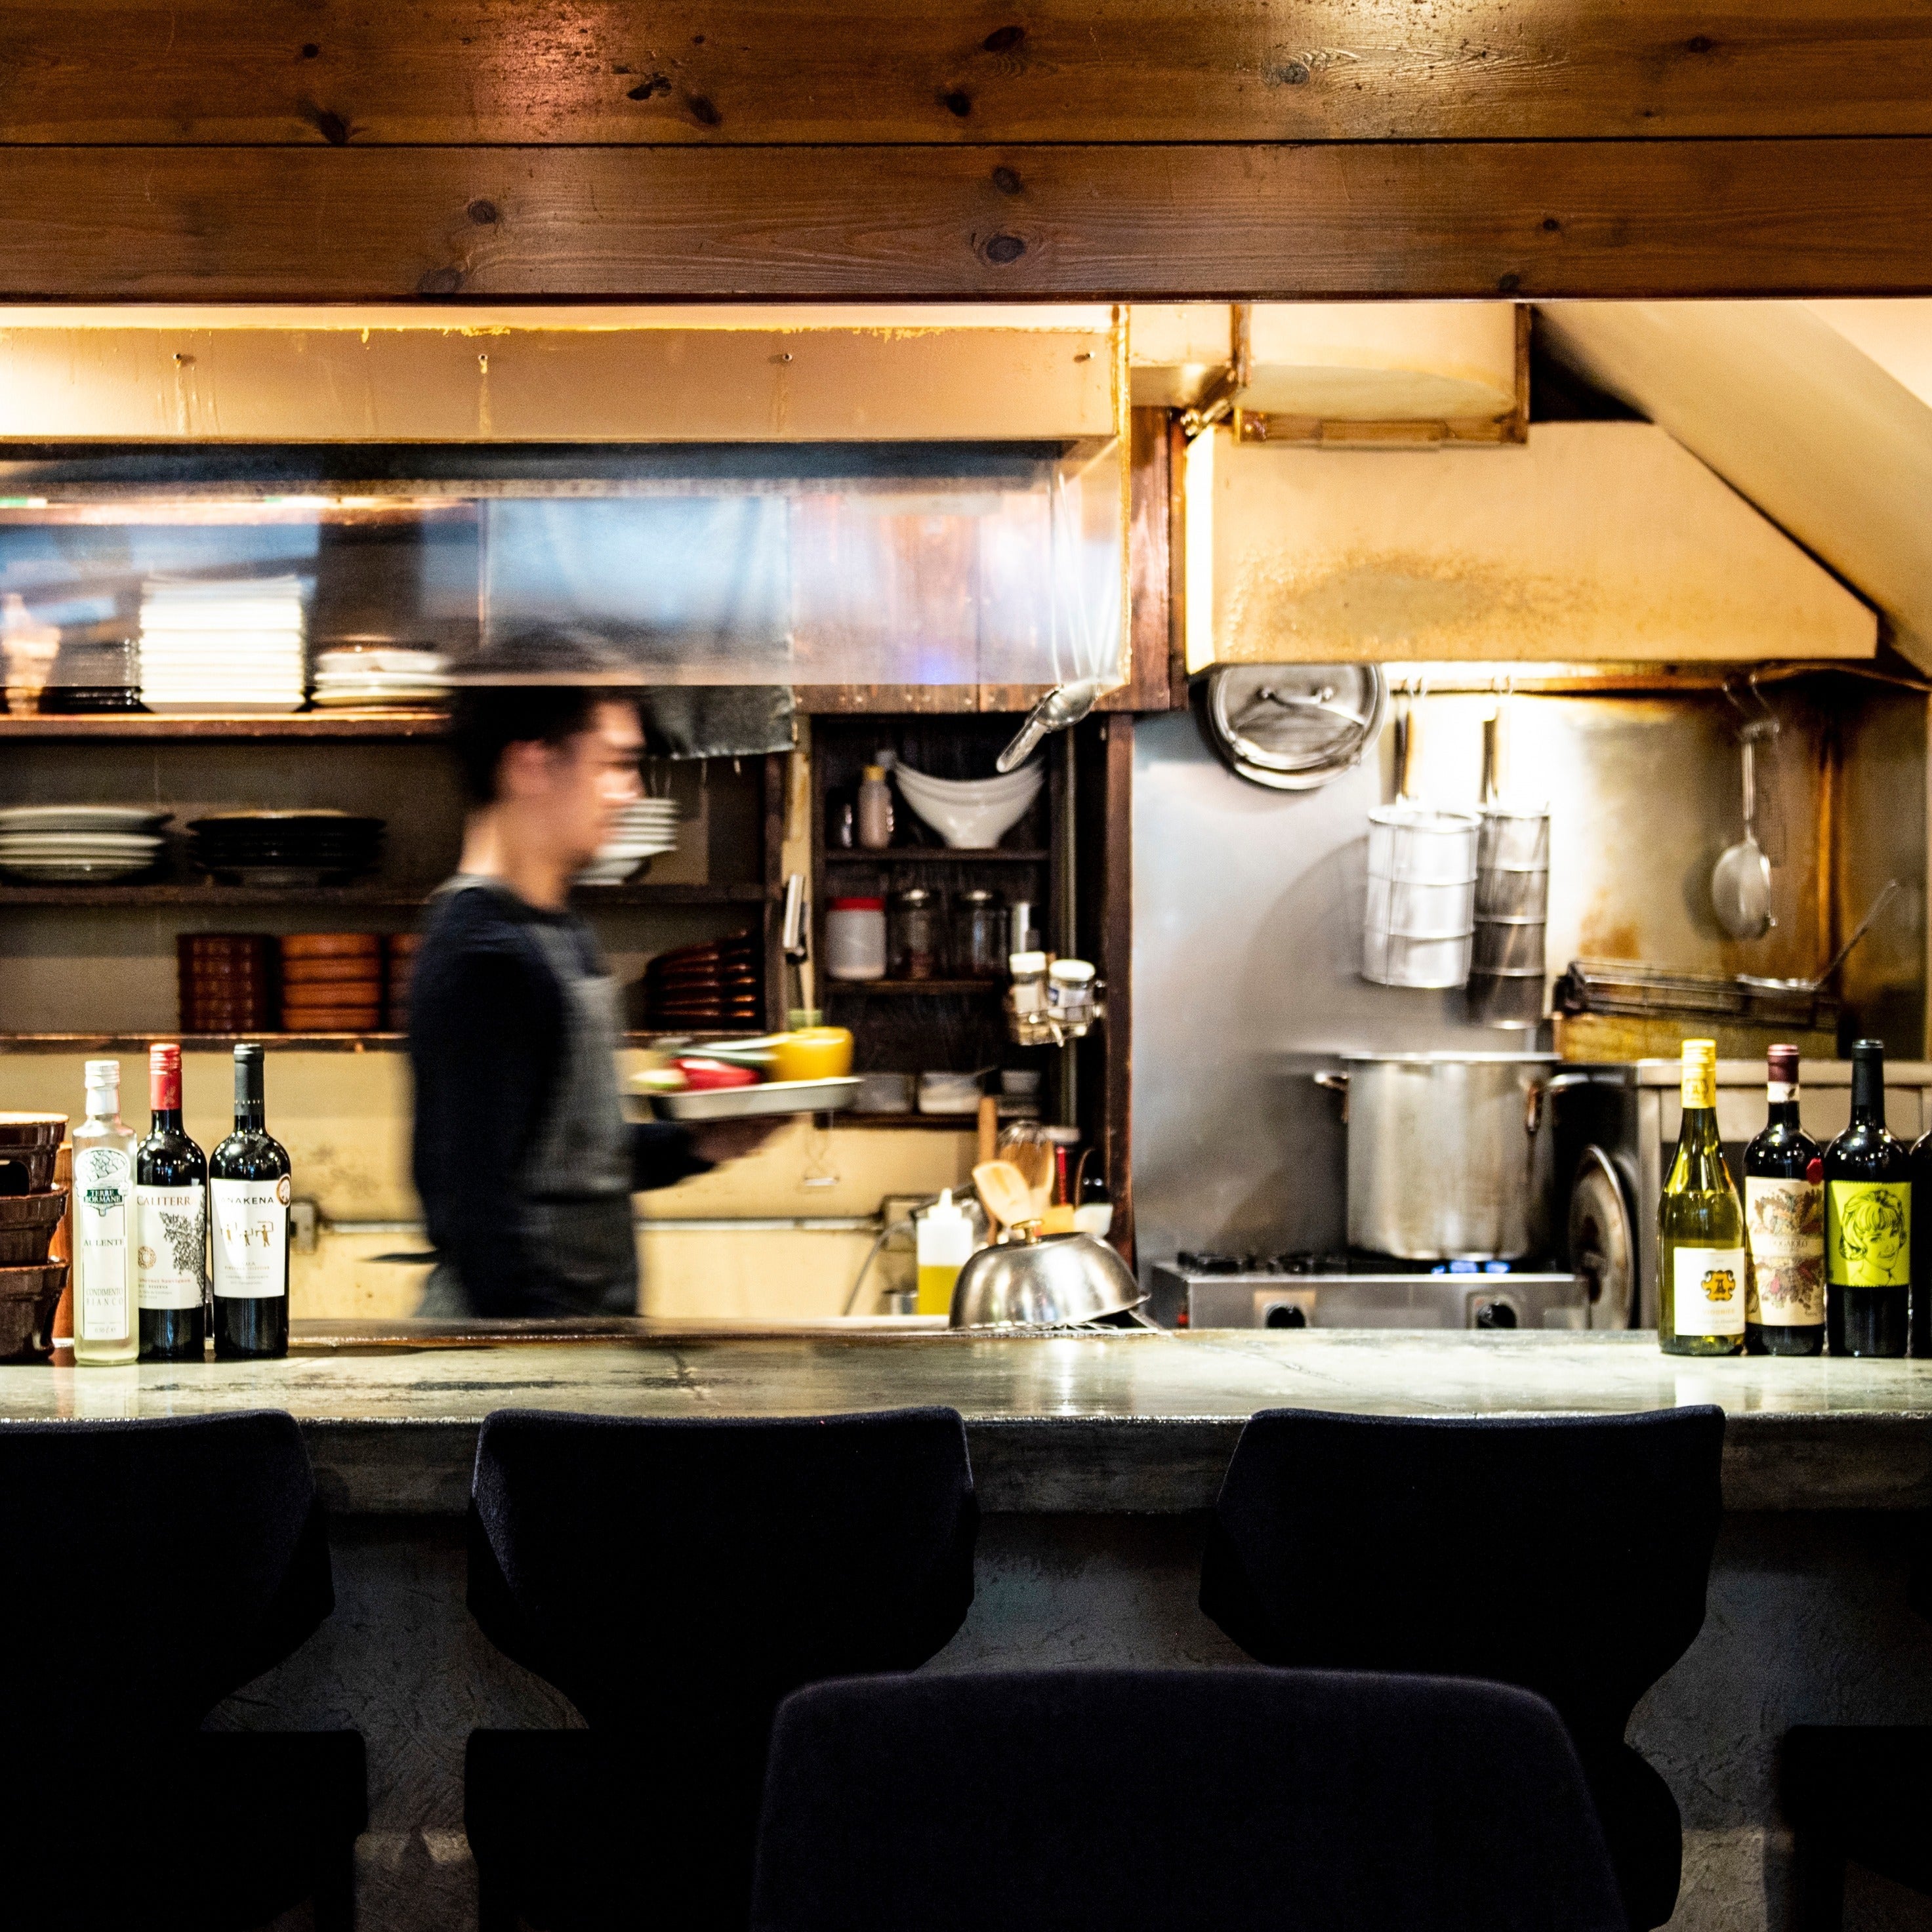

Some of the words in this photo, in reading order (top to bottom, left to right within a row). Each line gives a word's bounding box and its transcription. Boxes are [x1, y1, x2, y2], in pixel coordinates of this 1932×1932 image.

[136, 1196, 196, 1206] CALITERR
[86, 1288, 123, 1296] CONDIMENTO
[86, 1298, 123, 1306] BIANCO
